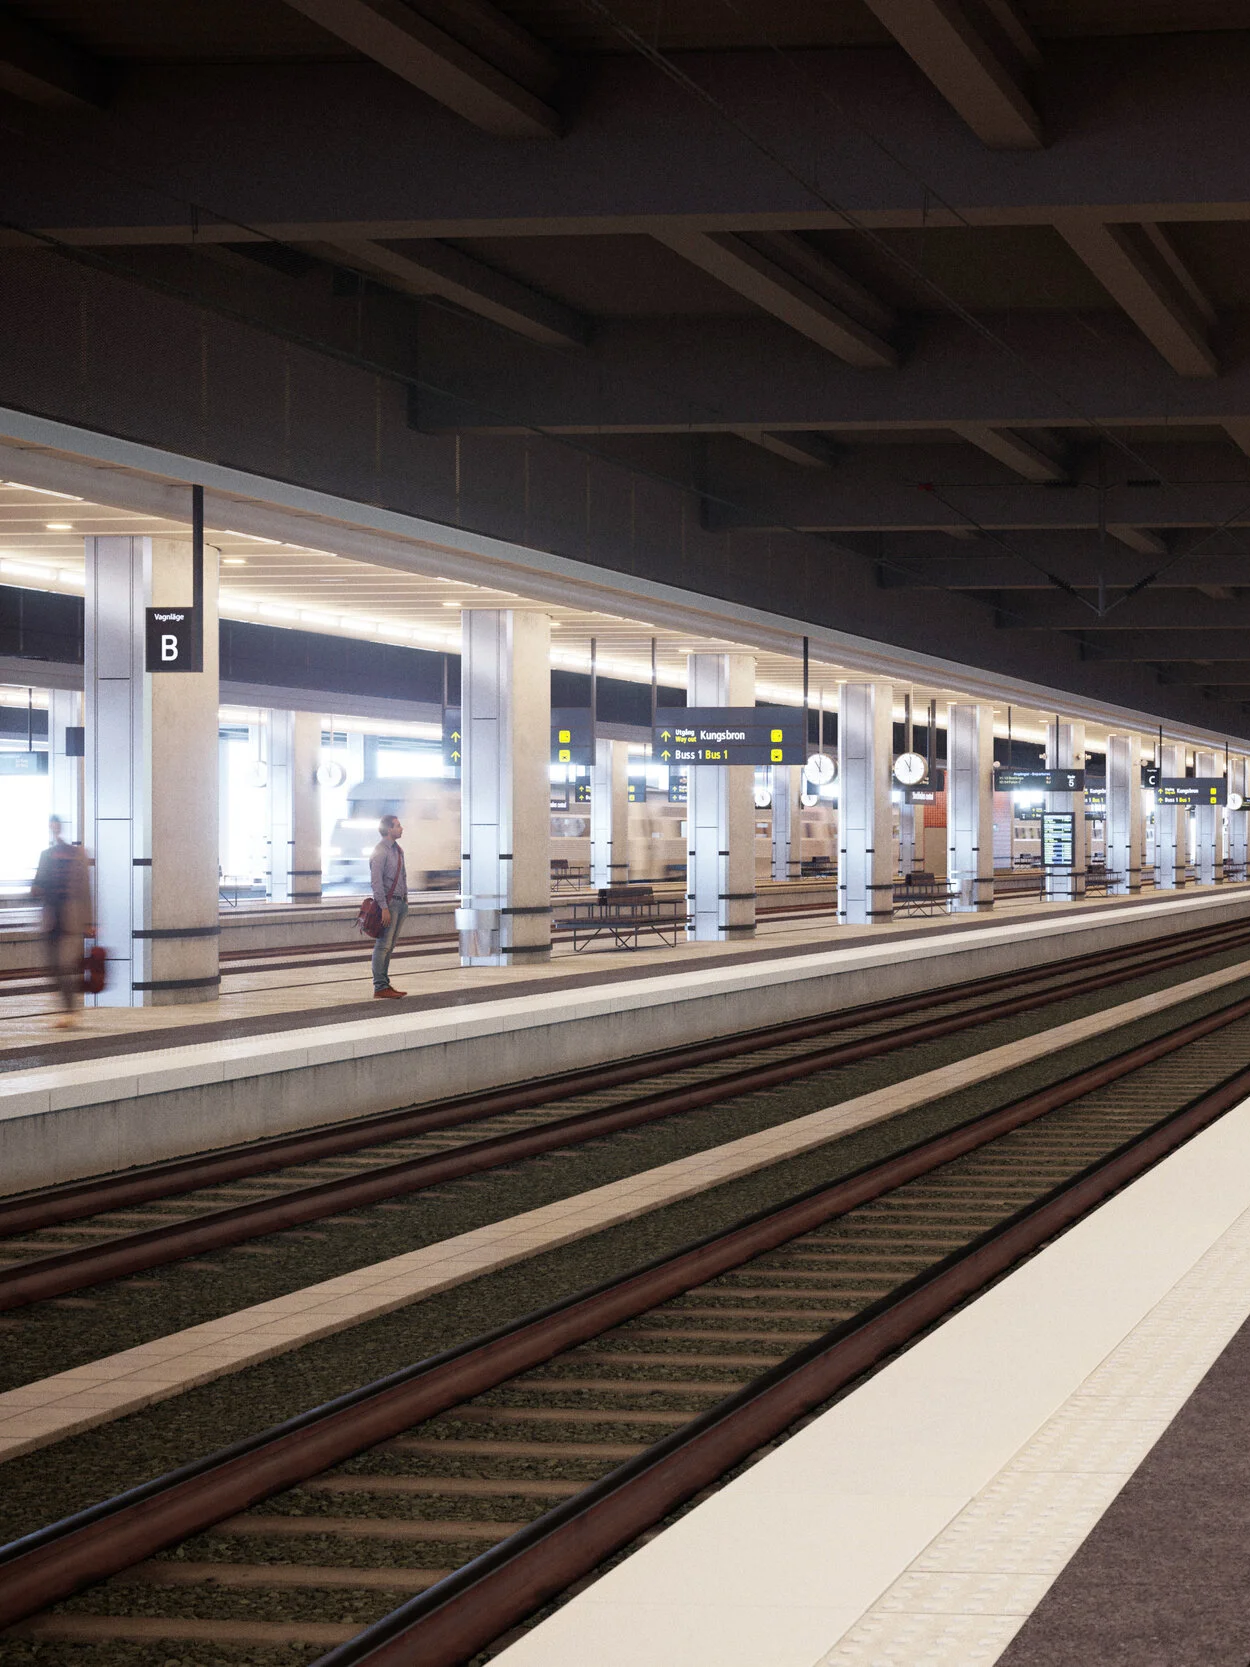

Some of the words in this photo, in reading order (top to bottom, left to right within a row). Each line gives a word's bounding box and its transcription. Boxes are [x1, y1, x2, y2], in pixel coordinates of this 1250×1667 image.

[154, 613, 185, 622] Vagnläge
[161, 634, 179, 661] B
[675, 729, 695, 737] Utgång
[700, 730, 745, 742] Kungsbron
[675, 736, 687, 744] Way
[675, 750, 695, 760] Buss
[698, 750, 703, 760] 1
[705, 750, 721, 760] Bus
[723, 750, 728, 760] 1
[1068, 779, 1075, 787] 5
[1149, 775, 1156, 785] C
